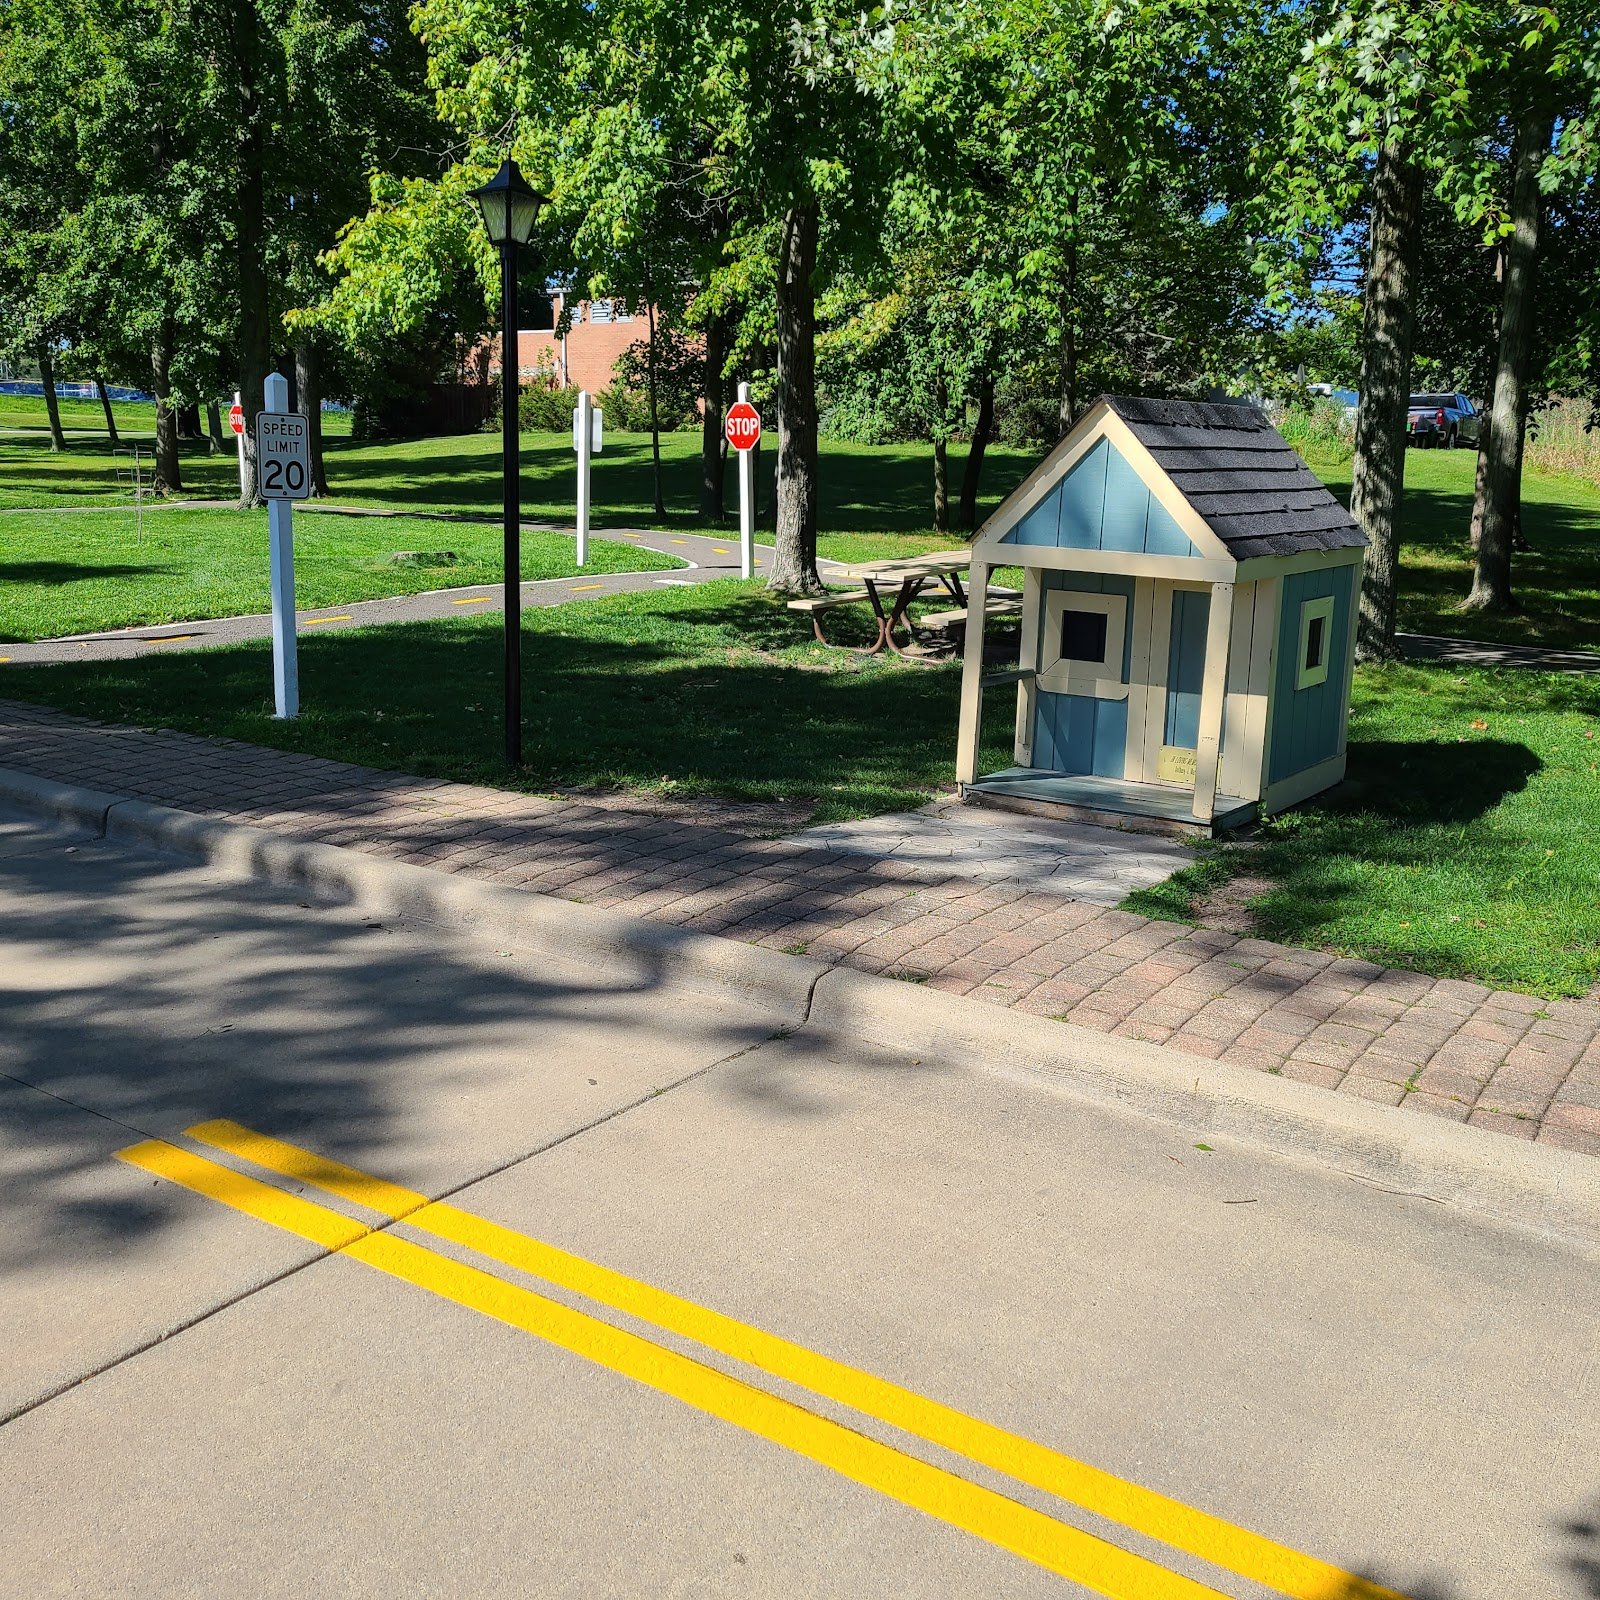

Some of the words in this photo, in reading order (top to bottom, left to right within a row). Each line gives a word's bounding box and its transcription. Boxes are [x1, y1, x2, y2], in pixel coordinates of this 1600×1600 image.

[230, 413, 243, 426] STO
[727, 417, 758, 436] STOP
[263, 422, 303, 437] SPEED
[267, 440, 300, 453] LIMIT
[264, 459, 305, 491] 20
